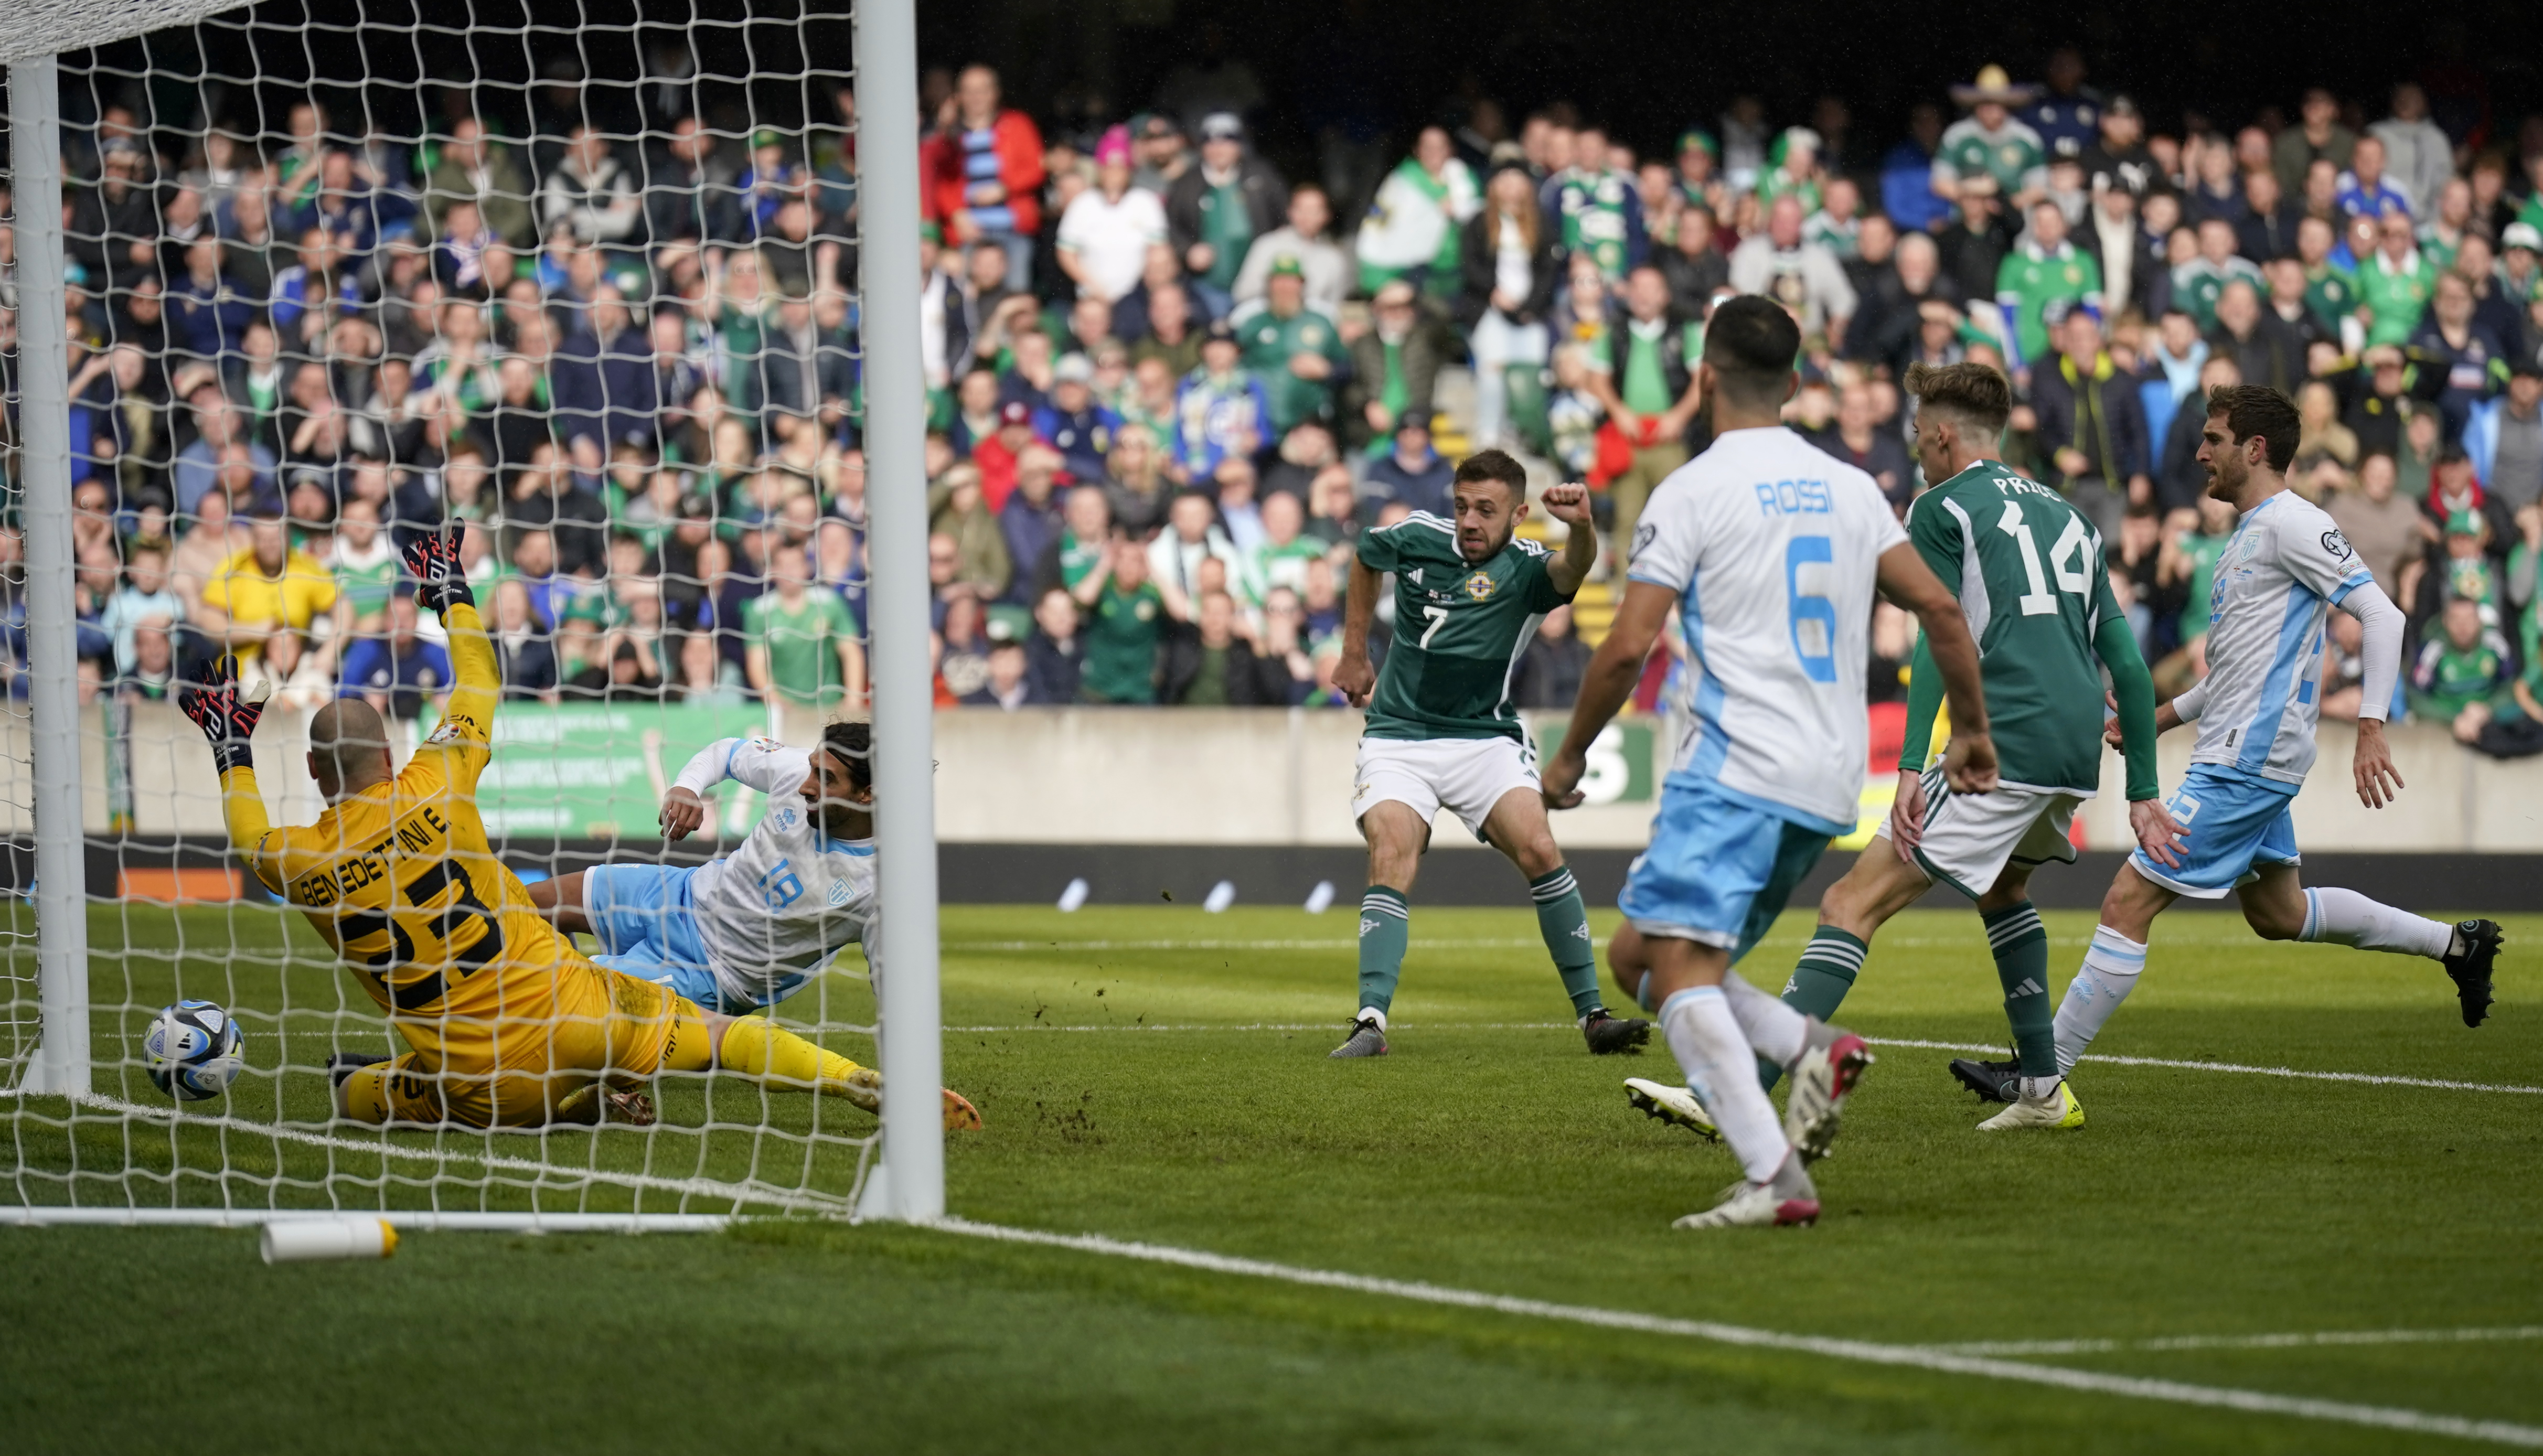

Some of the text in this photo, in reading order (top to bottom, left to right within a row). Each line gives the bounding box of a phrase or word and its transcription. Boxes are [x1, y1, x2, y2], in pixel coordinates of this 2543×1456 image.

[1755, 479, 1833, 517] ROSSI
[1993, 477, 2061, 502] PRICE
[1996, 499, 2095, 616] 14
[1419, 605, 1448, 650] 7
[1786, 535, 1837, 682] 6
[300, 819, 433, 908] BENEDETTINI
[757, 858, 804, 914] 18
[332, 858, 505, 1010] 23
